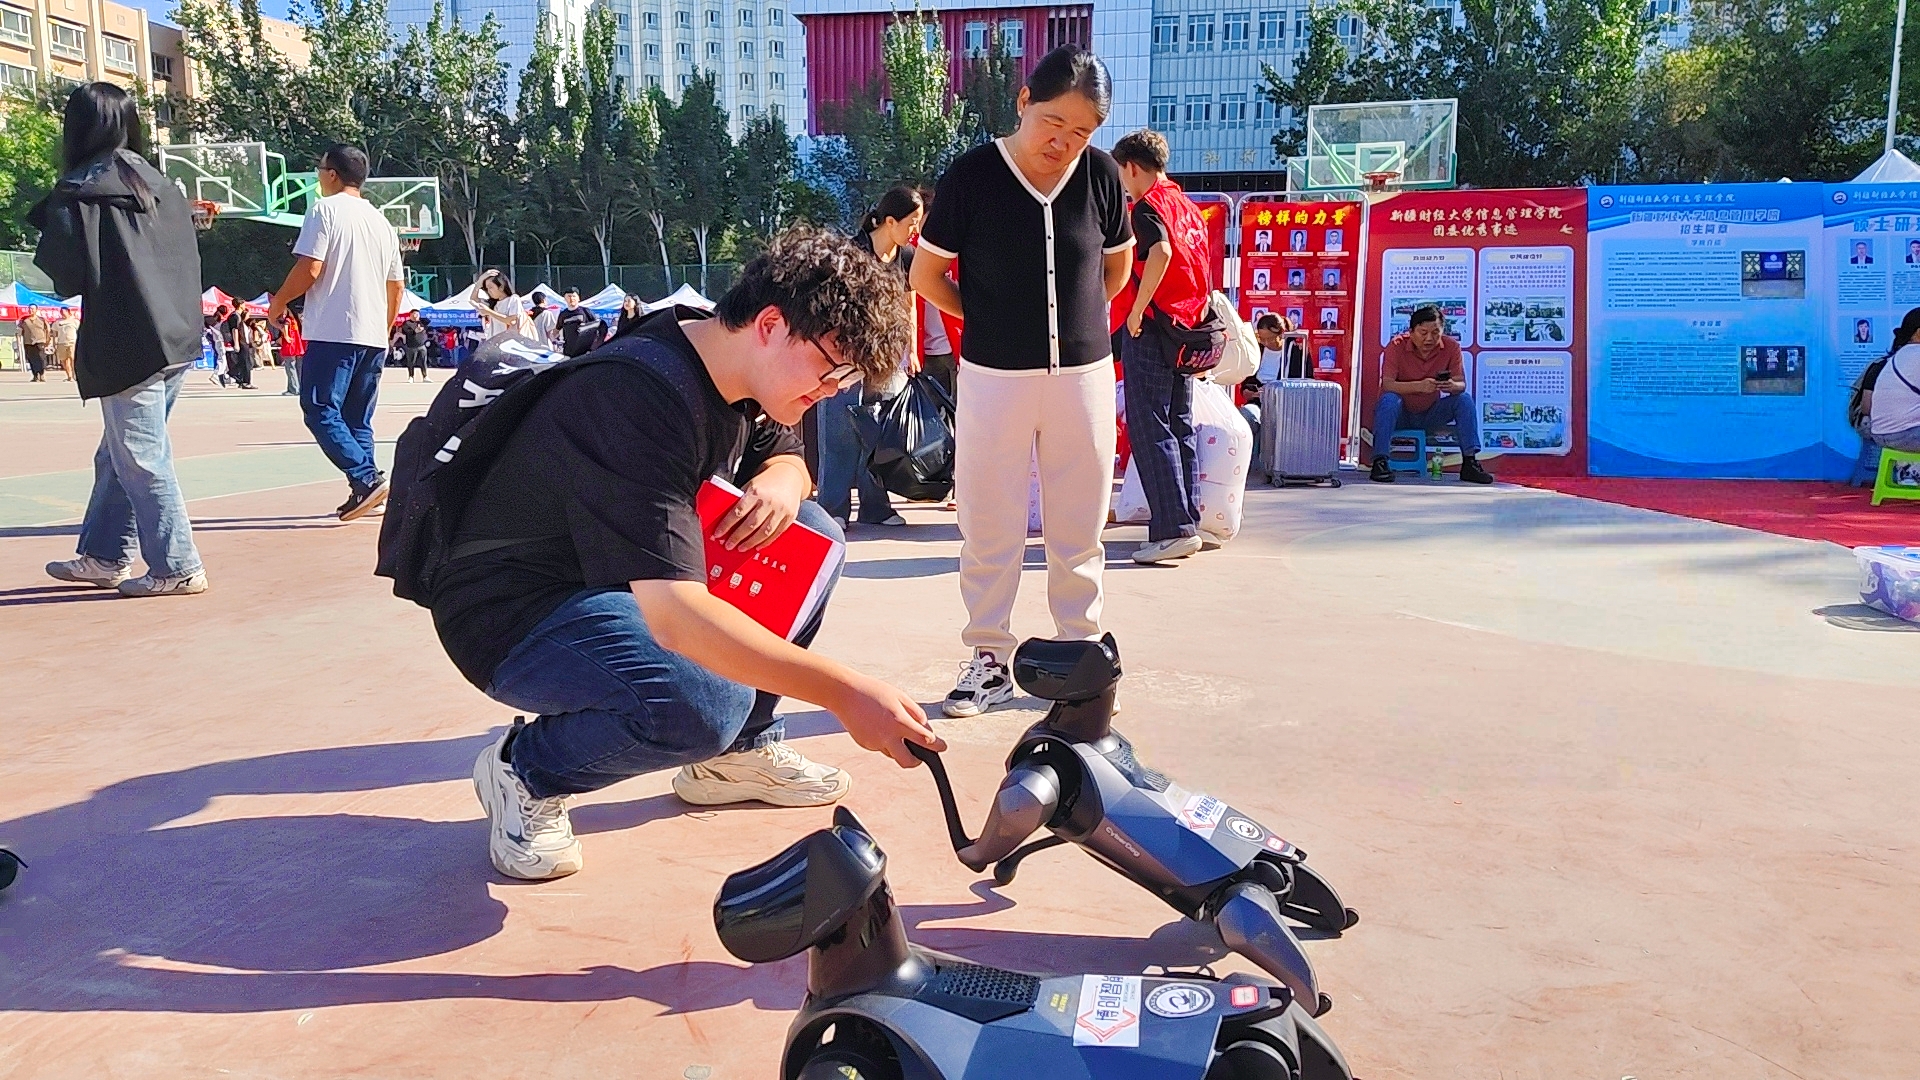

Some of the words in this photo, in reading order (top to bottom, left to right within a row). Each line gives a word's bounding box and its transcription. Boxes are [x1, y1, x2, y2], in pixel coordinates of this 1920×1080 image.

[1257, 208, 1347, 226] 榜样的力量
[1389, 206, 1563, 222] 新疆财经大学信息管理学院
[1630, 209, 1781, 223] 新疆财经大学信息管理学院
[1433, 222, 1519, 237] 团委优秀事迹
[1680, 224, 1728, 235] 招生简章
[1105, 826, 1141, 857] CyberDog
